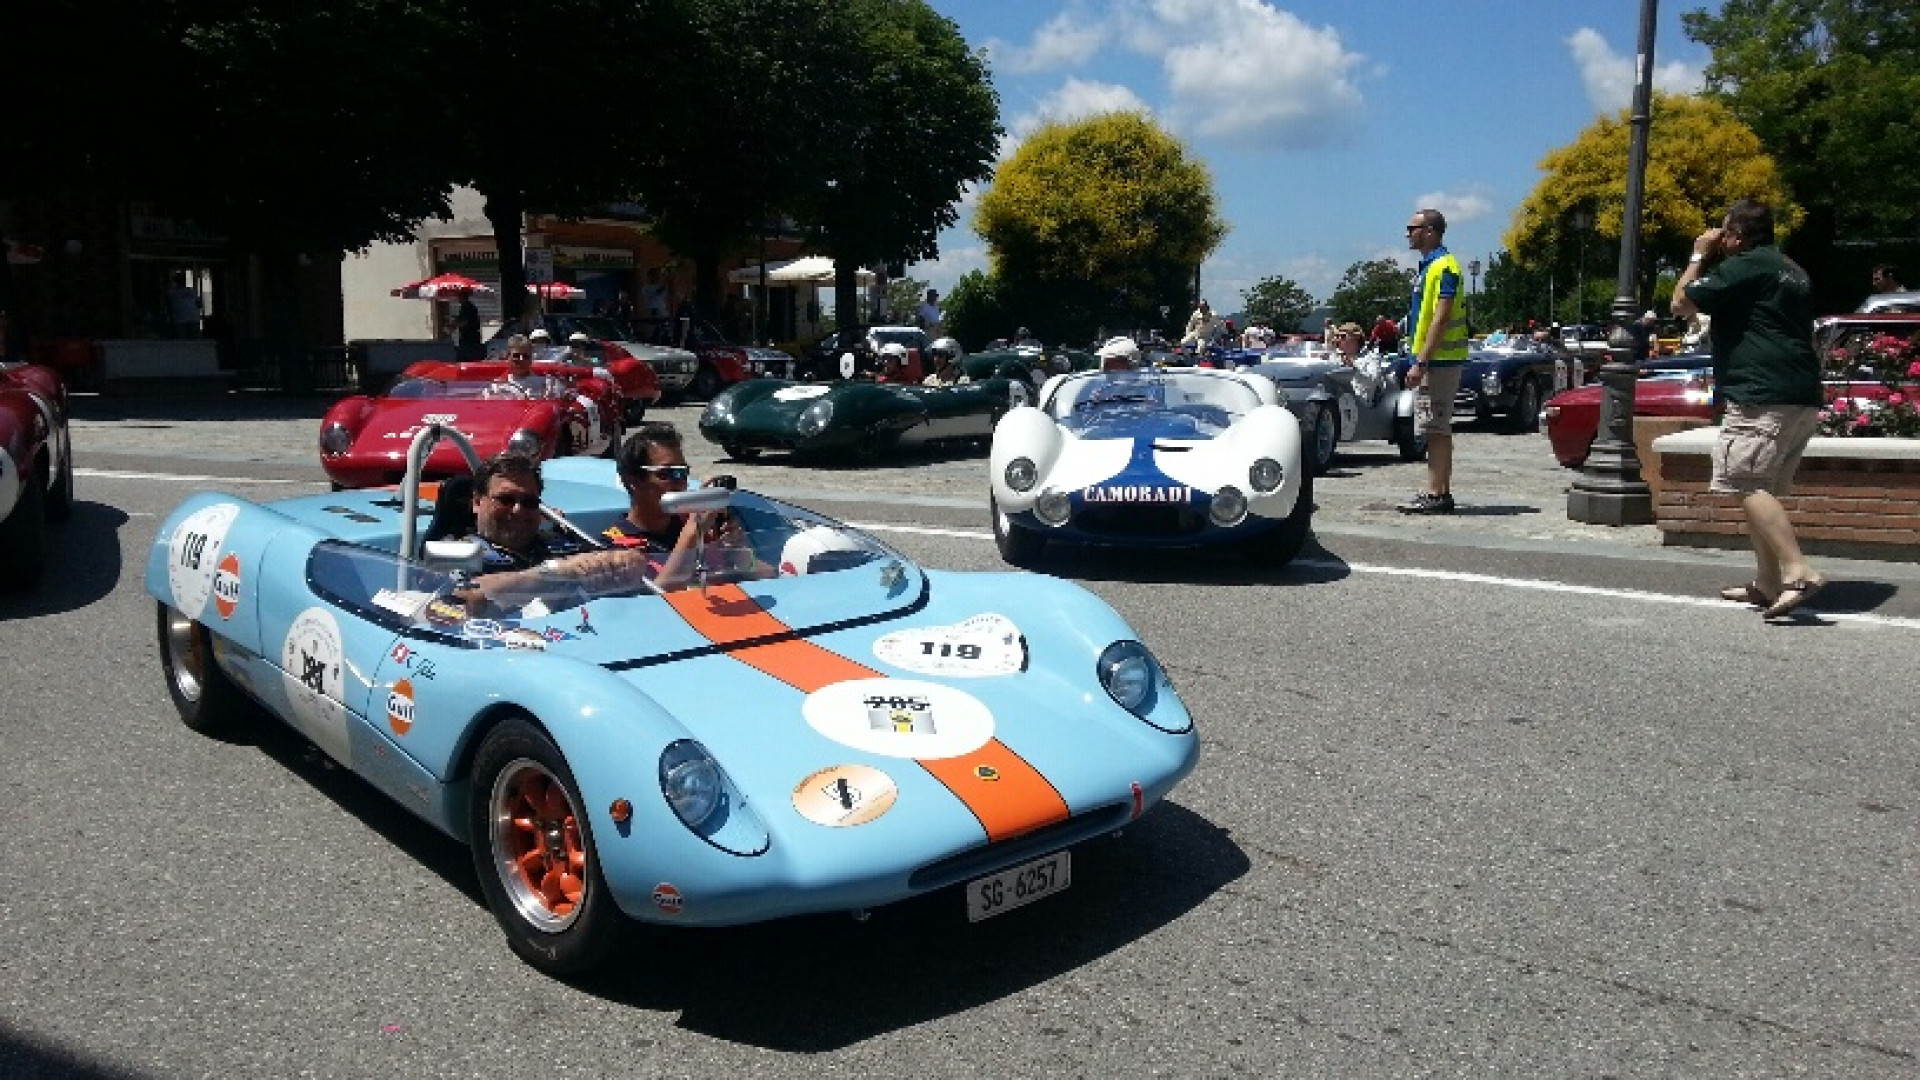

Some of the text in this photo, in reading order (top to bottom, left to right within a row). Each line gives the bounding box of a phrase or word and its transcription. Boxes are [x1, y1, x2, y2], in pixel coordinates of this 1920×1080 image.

[181, 532, 207, 569] 119
[919, 641, 981, 659] 119
[387, 695, 414, 720] Gulf
